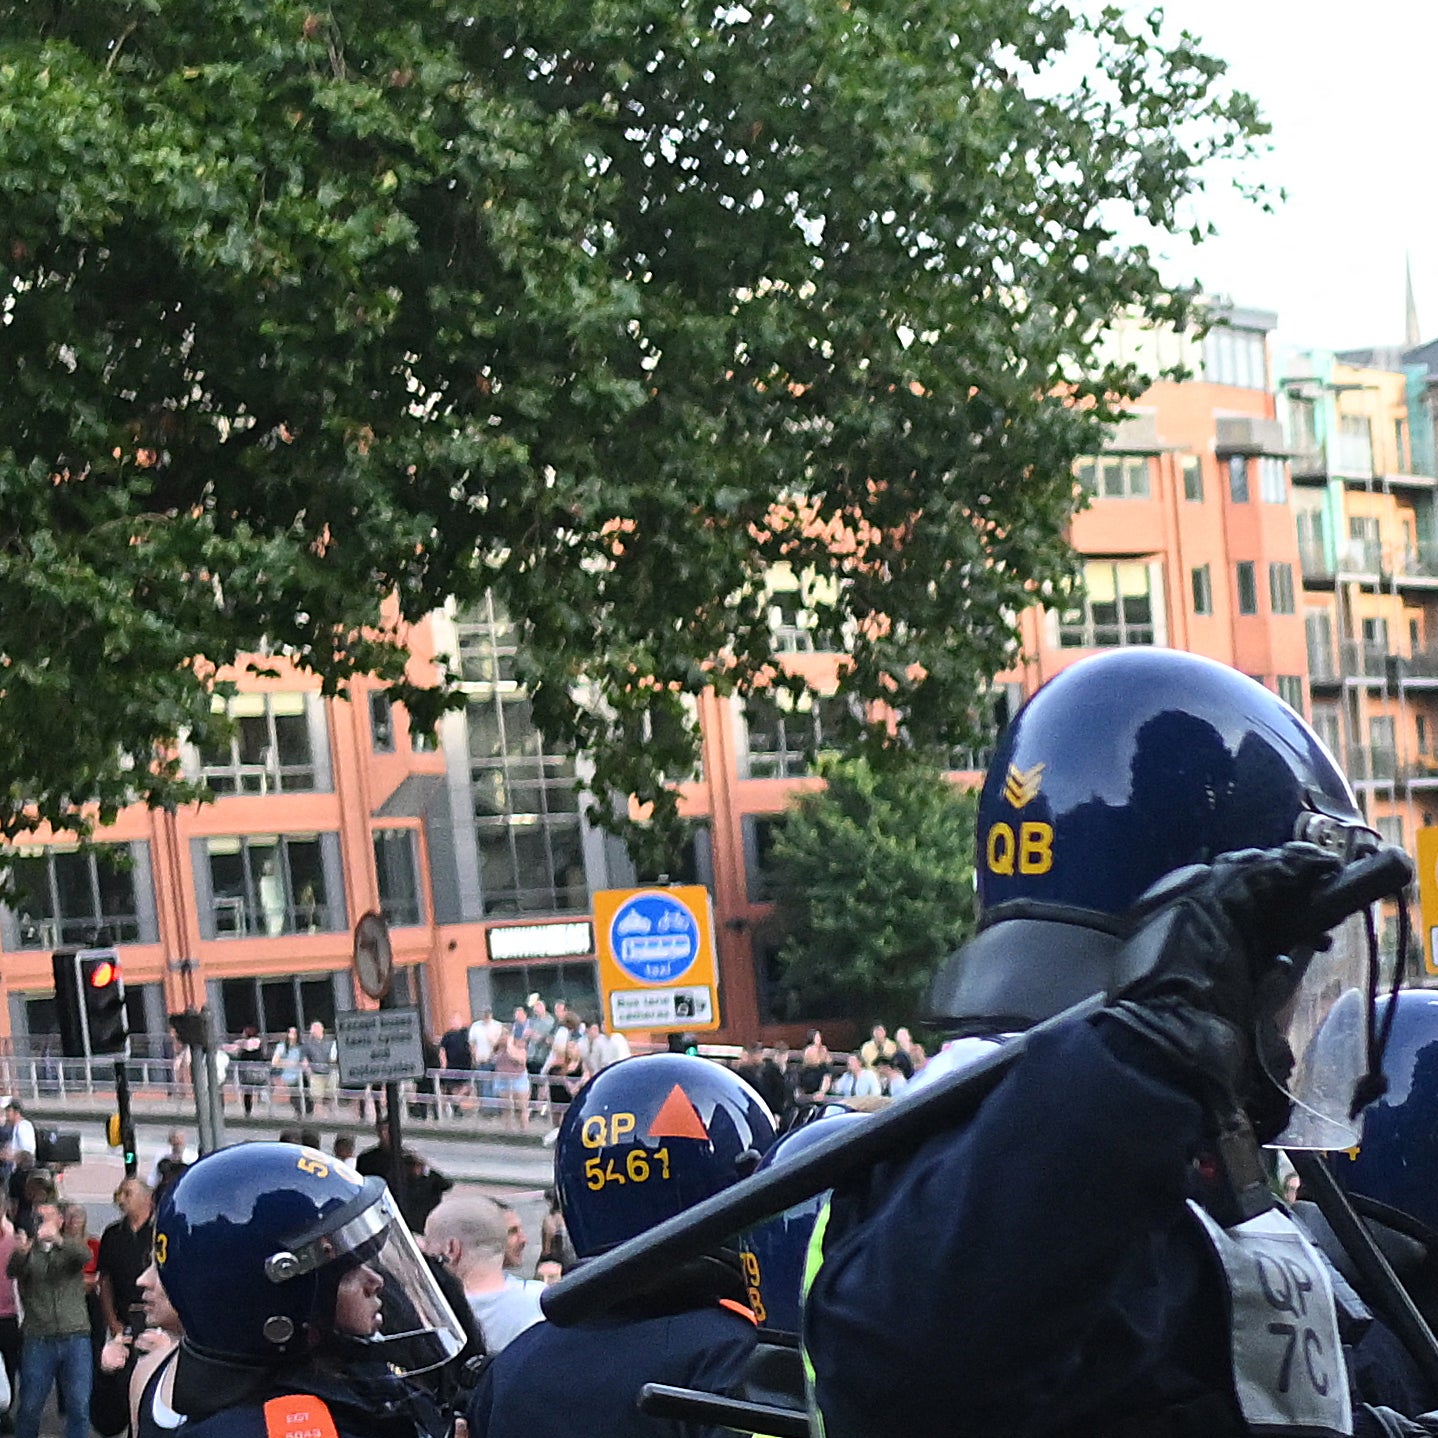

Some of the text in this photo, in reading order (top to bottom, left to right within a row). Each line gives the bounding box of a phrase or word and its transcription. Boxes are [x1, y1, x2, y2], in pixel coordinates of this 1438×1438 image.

[986, 821, 1054, 876] QB
[581, 1112, 637, 1149] QP
[584, 1147, 671, 1191] 5461
[1252, 1250, 1314, 1320] QP
[1267, 1321, 1329, 1397] 7C
